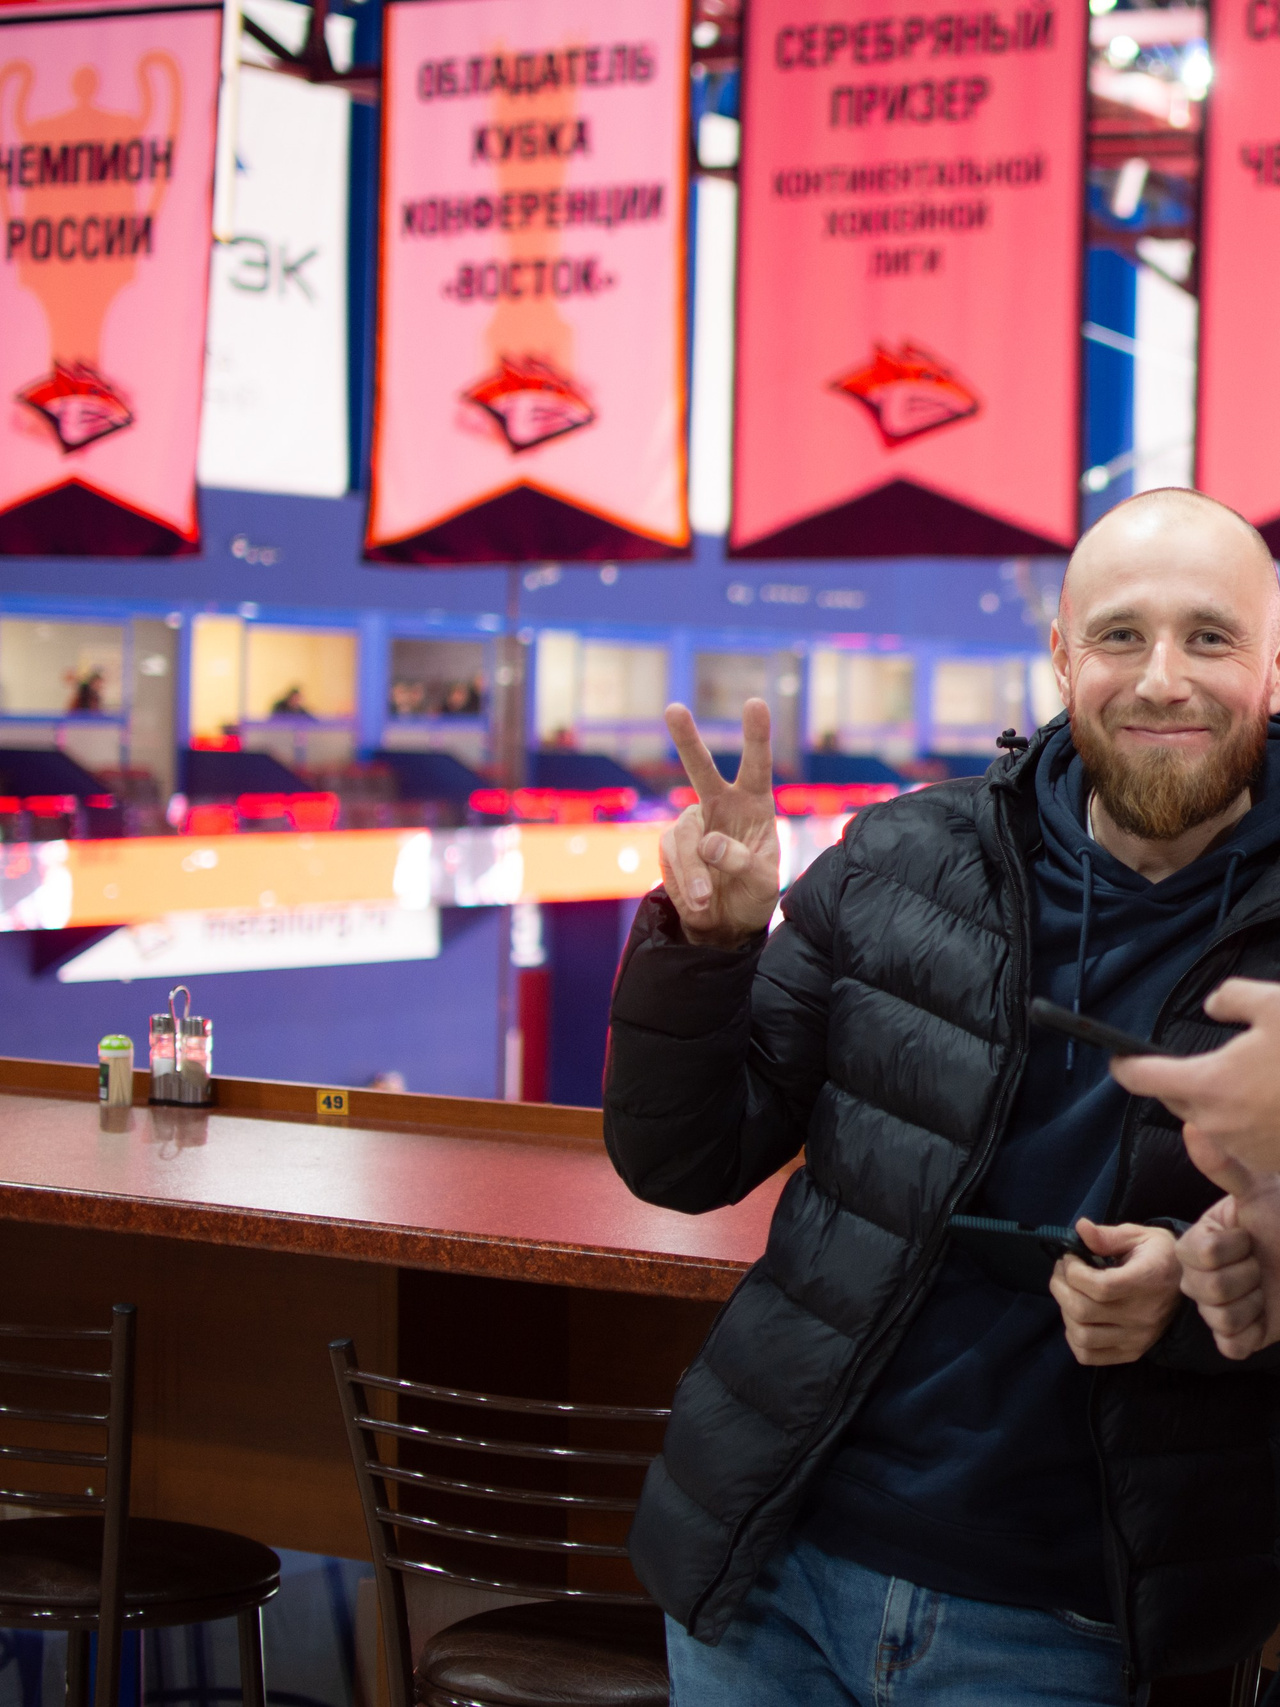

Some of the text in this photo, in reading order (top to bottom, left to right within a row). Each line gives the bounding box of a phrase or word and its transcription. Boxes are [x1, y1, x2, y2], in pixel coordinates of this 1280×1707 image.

[774, 4, 1054, 70] СЕРЕБРЯНЫЙ
[416, 44, 656, 101] ОБЛАДАТЕЛЬ
[829, 76, 990, 127] ПРИЗЕР
[471, 117, 589, 164] КУБКА
[772, 152, 1044, 198] КОНТИНЕНТАЛЬНОЙ
[401, 184, 665, 238] КОНФЕРЕНЦИИ
[6, 215, 153, 263] РОССИИ
[321, 1095, 344, 1110] 49
